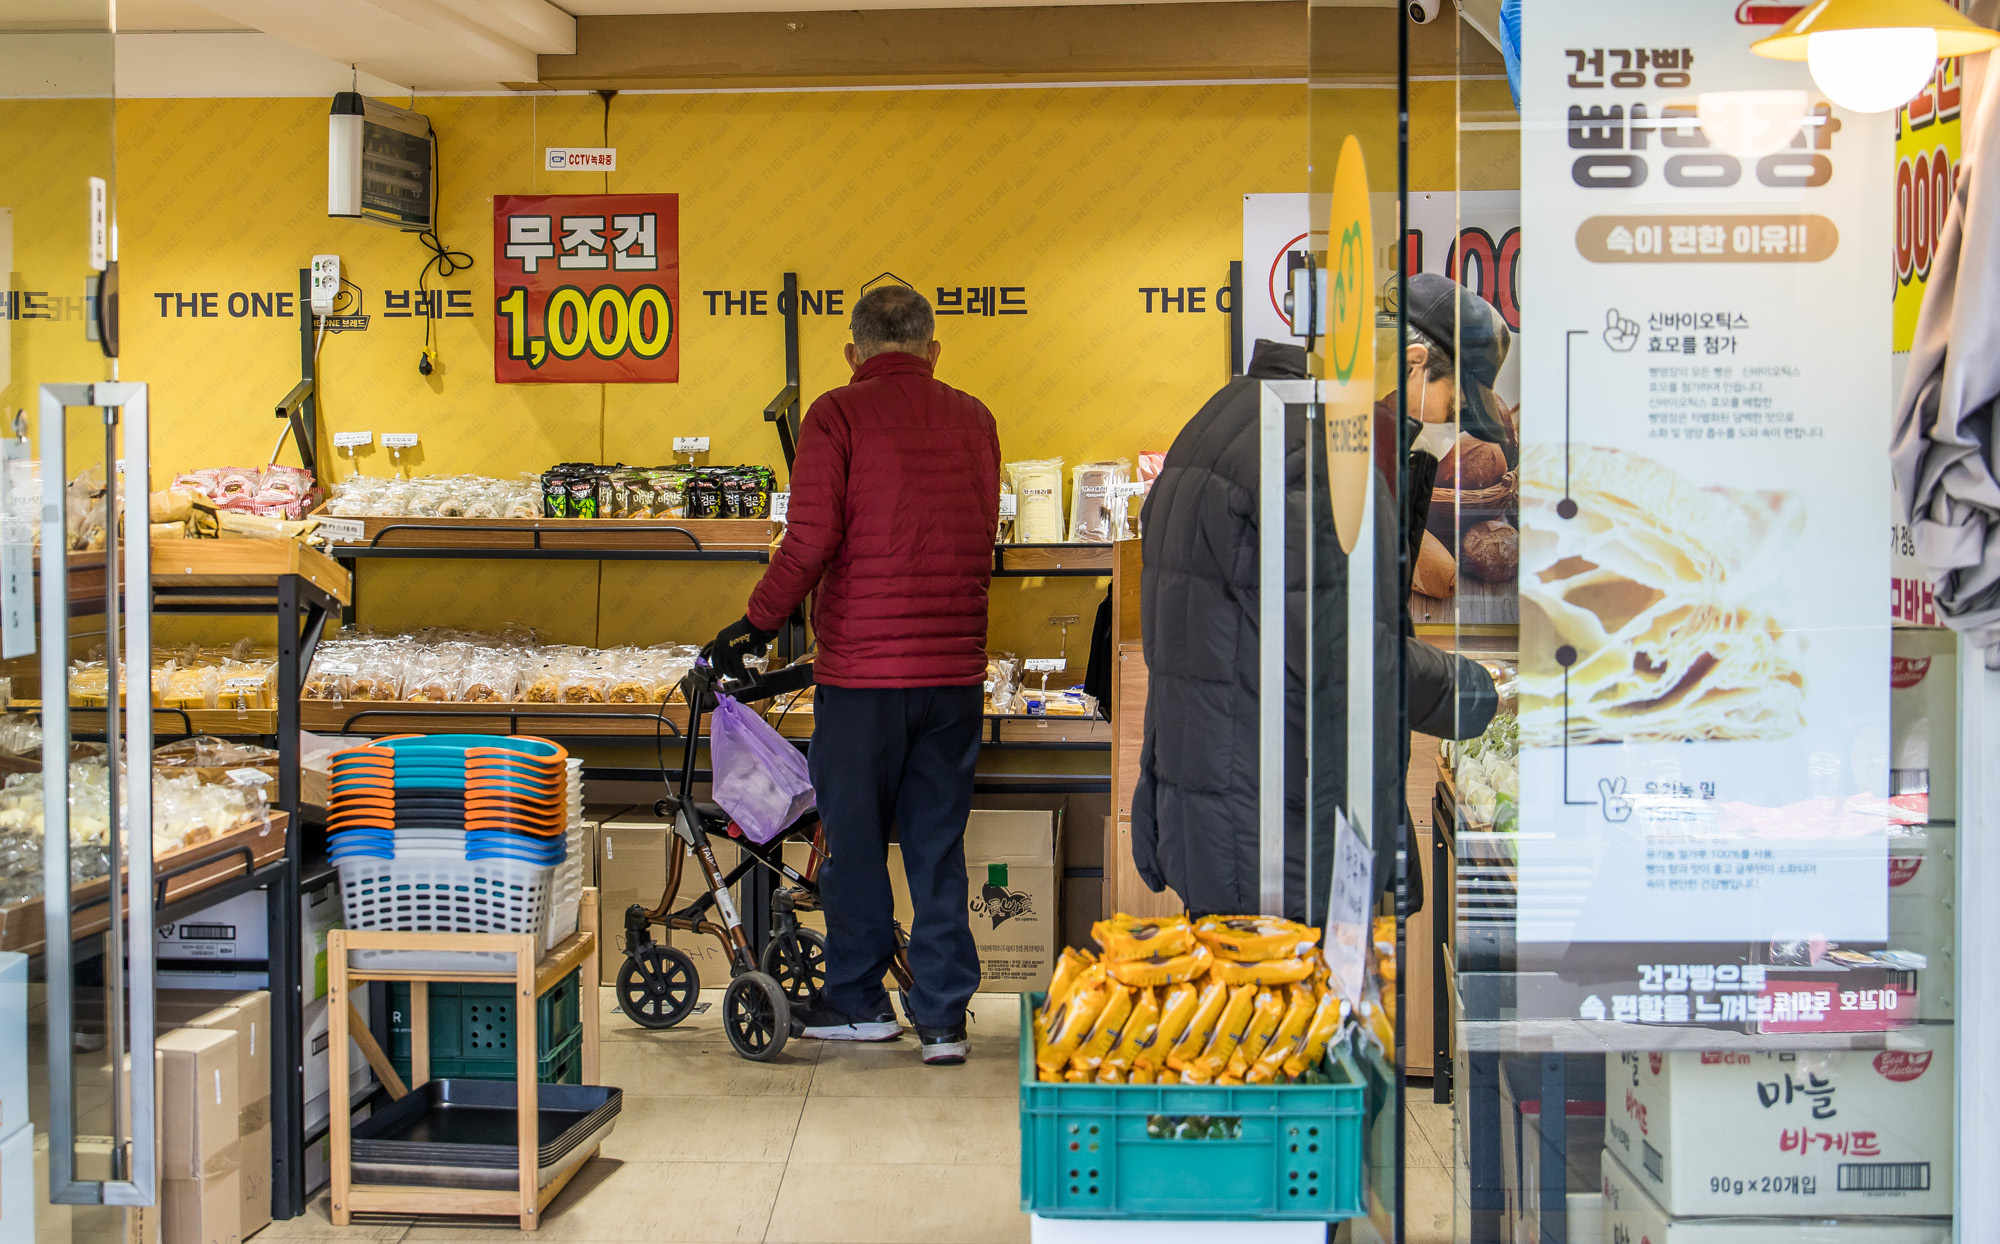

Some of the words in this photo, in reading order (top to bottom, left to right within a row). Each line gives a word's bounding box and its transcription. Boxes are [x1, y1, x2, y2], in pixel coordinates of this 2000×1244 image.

[1565, 48, 1694, 88] 건강빵
[568, 153, 612, 166] CCTV녹화중
[505, 213, 658, 274] 무조건
[1606, 224, 1662, 254] 속이
[1669, 224, 1727, 254] 편한
[1732, 224, 1808, 254] 이유!!
[154, 292, 218, 317] THE
[227, 292, 294, 317] ONE
[383, 289, 474, 319] 브레드
[702, 290, 767, 315] THE
[935, 286, 1028, 316] 브레드
[1138, 287, 1206, 314] THE
[342, 319, 365, 328] 브레드
[497, 285, 672, 369] 1,000
[1647, 312, 1749, 331] 신바이오틱스
[1647, 336, 1697, 354] 효모를
[1704, 336, 1737, 354] 첨가
[1637, 964, 1767, 992] 건강빵으로
[1579, 994, 1606, 1020] 속
[1757, 1073, 1838, 1120] 마늘
[1779, 1126, 1882, 1157] 바게뜨
